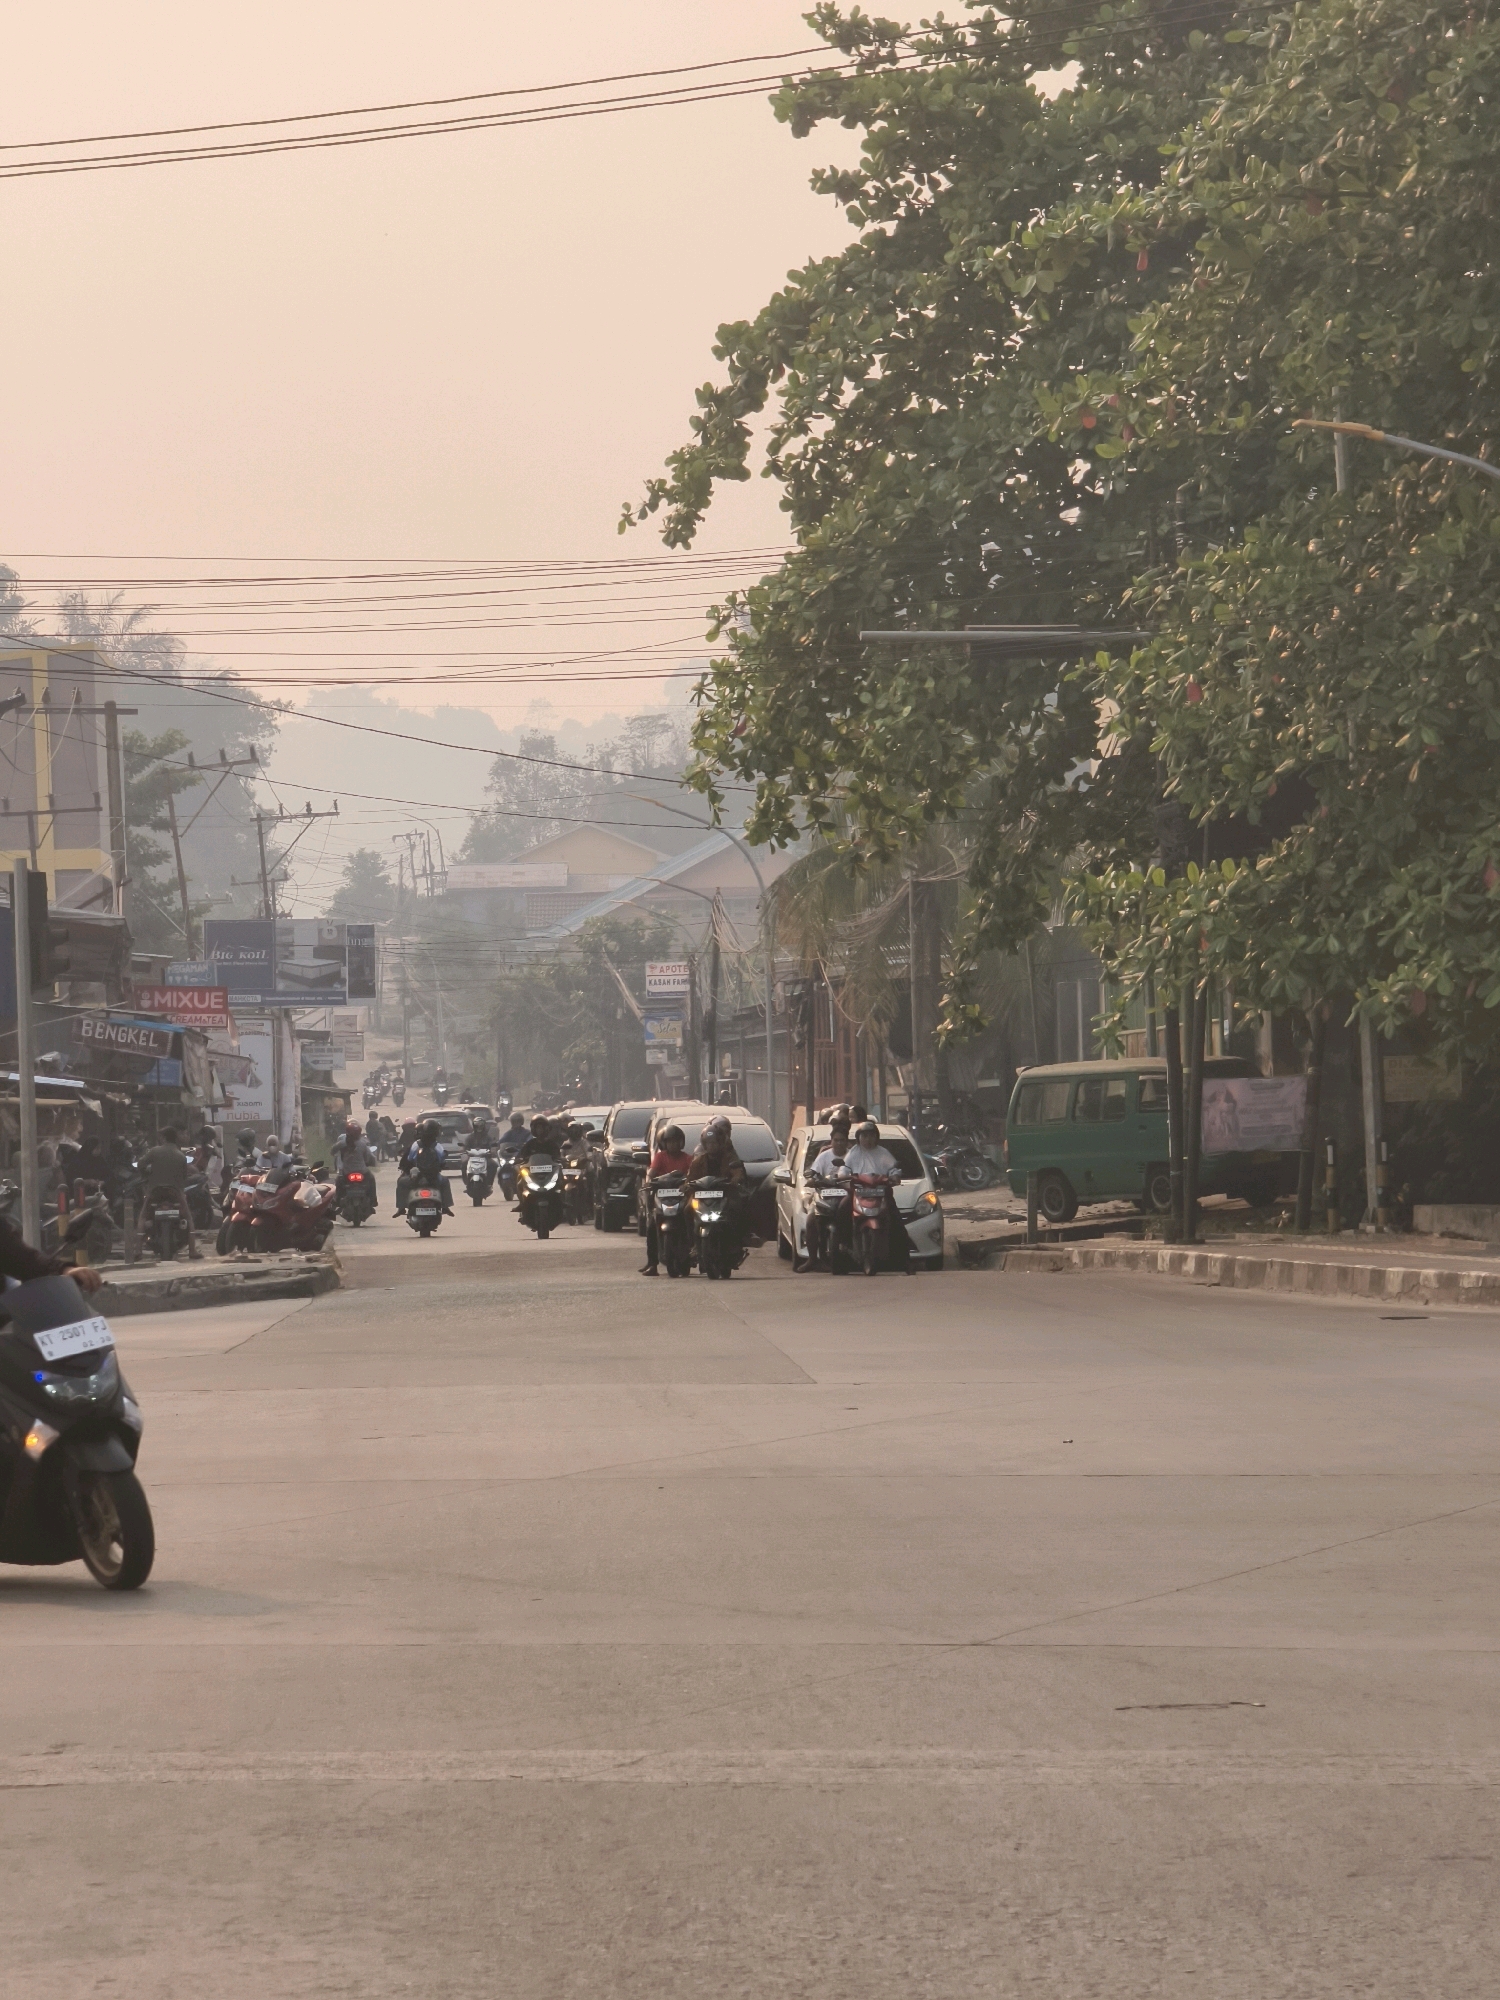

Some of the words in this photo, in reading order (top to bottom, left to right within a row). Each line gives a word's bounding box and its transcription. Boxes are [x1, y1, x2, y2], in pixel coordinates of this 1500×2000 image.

[167, 963, 209, 974] MEGAMAN
[659, 965, 689, 974] APOTE
[154, 991, 224, 1009] MIXUE
[81, 1019, 158, 1047] BENGKEL
[226, 1110, 260, 1120] nubia
[38, 1333, 53, 1347] KT
[59, 1325, 86, 1341] 2507
